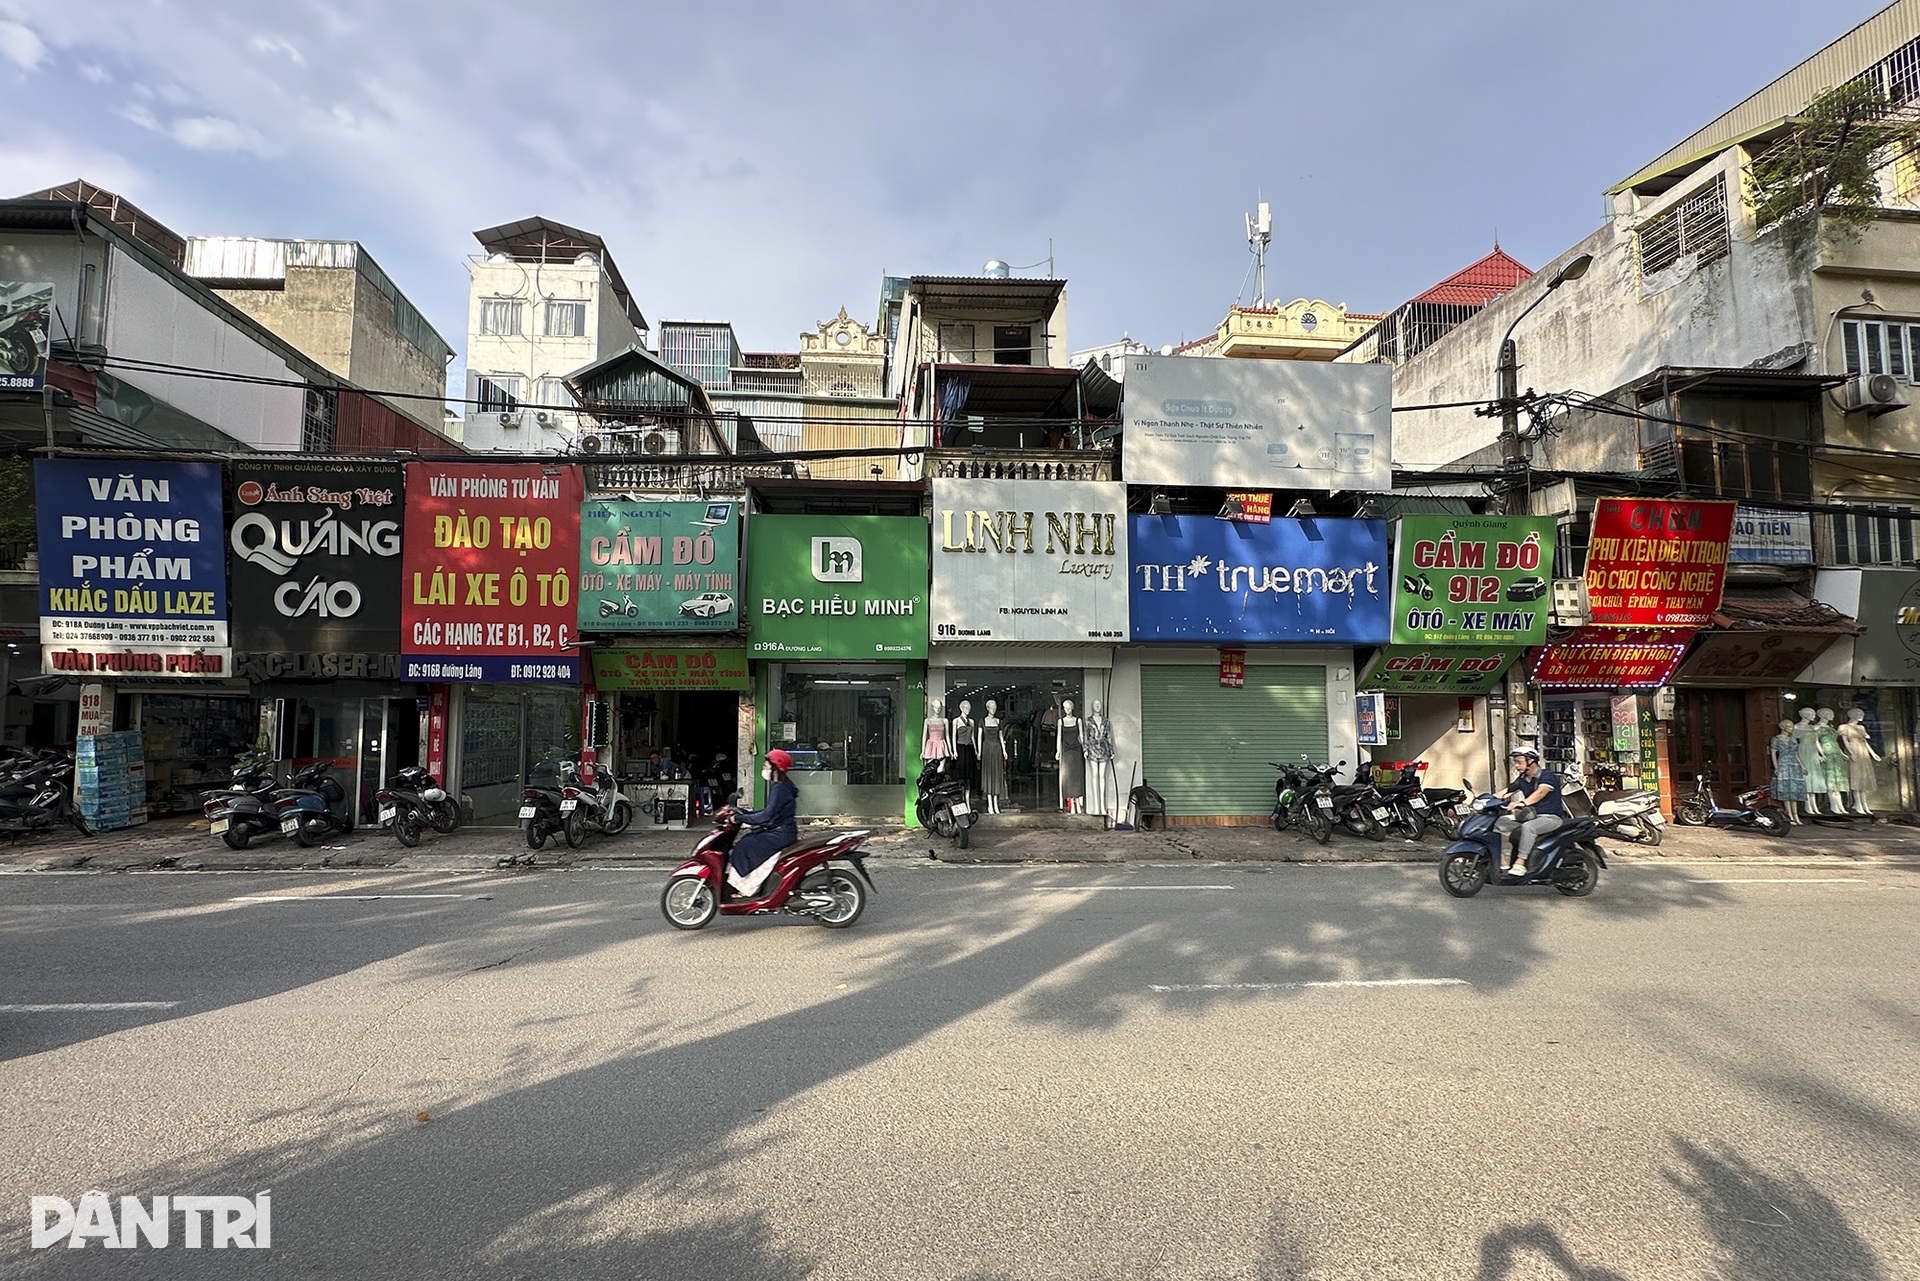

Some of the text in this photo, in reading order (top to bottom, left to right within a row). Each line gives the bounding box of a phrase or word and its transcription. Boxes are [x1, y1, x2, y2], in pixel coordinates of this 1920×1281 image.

[88, 474, 170, 502] VĂN
[430, 473, 457, 498] VĂN
[461, 474, 507, 498] PHÒNG
[512, 477, 530, 498] TƯ
[62, 512, 200, 542] PHÒNG
[434, 508, 551, 556] ĐÀO TẠO
[942, 510, 1116, 555] LINH NHI
[1483, 520, 1507, 530] Giang
[231, 507, 400, 576] QUẢNG
[1413, 530, 1540, 570] CẦM ĐỒ
[1589, 536, 1728, 567] PHỤ KIỆN ĐIỆN THOẠI
[72, 548, 191, 580] PHẨM
[1059, 560, 1114, 579] Luxury
[1136, 560, 1379, 593] TH truemart
[413, 566, 570, 606] LÁI XE Ô TÔ
[616, 574, 631, 591] XE
[636, 571, 662, 591] MÁY
[674, 571, 701, 591] MÁY
[705, 571, 732, 591] TÍNH
[1448, 576, 1500, 603] 912
[1640, 567, 1676, 591] CÔNG
[1679, 569, 1715, 595] NGHỆ
[50, 580, 216, 615] KHẮC DẤU LAZE
[274, 575, 361, 618] CÁO
[762, 598, 804, 618] BẠC
[1665, 597, 1685, 609] THAY
[938, 624, 956, 635] 916
[1407, 608, 1535, 630] ÔTÔ XE MÁY
[414, 618, 441, 645] CÁC
[445, 623, 482, 650] HẠNG
[486, 624, 504, 645] XE
[508, 624, 529, 648] B1,
[533, 624, 554, 649] B2,
[762, 642, 784, 651] 916A
[95, 649, 163, 672] PHÒNG
[408, 664, 571, 679] ĐC: 916B đường Láng ĐT: 0912 928 404
[1384, 652, 1506, 672] CẦM ĐỒ
[82, 695, 100, 707] 918
[82, 711, 100, 720] MUA
